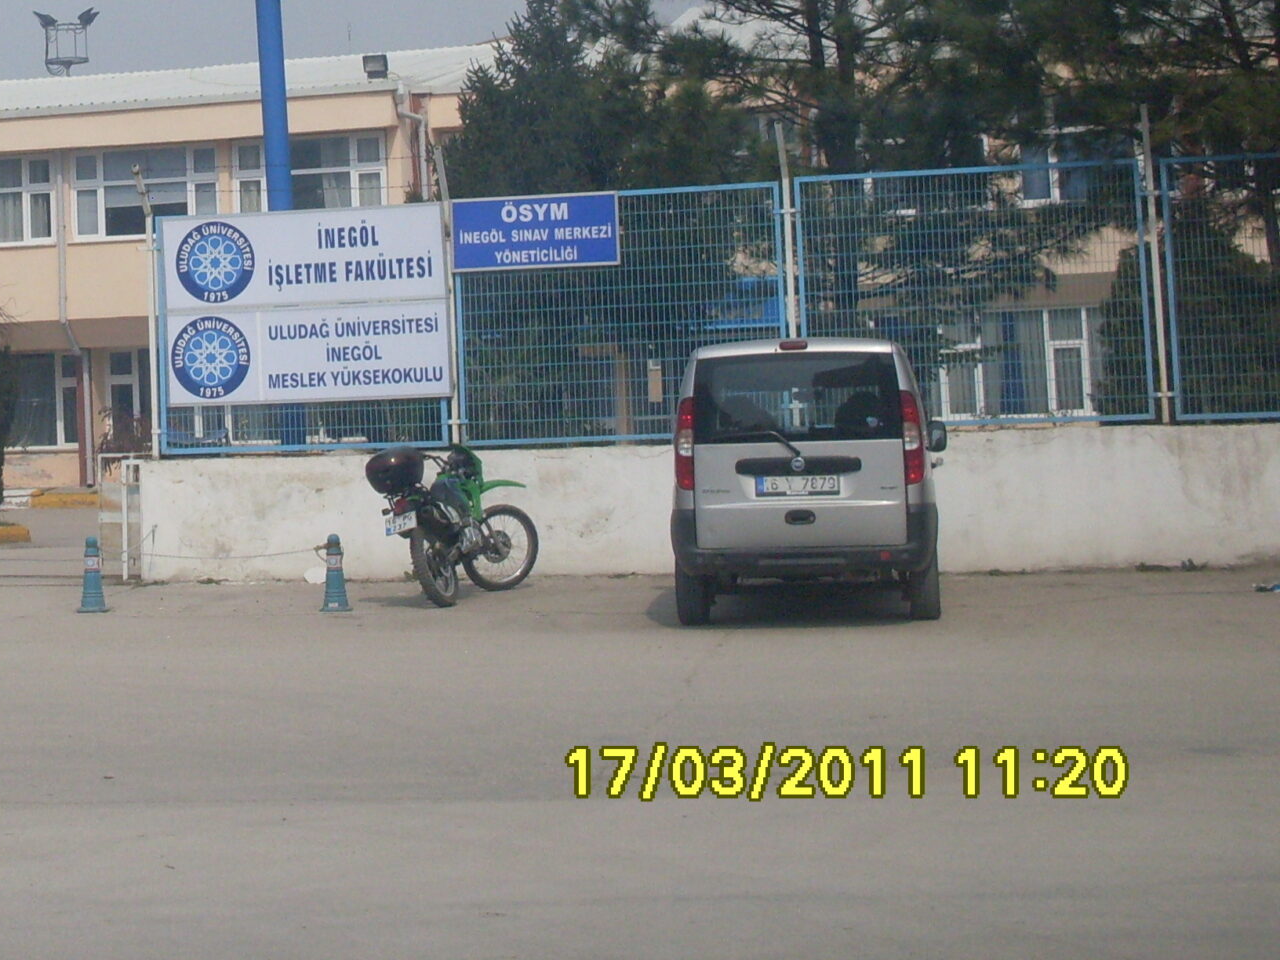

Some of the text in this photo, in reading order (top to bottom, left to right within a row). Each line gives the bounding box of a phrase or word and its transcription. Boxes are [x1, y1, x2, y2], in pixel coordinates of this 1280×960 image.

[500, 201, 568, 223] ÖSYM
[317, 219, 380, 250] İNEGÖL
[459, 222, 612, 245] İNEGÖL SINAV MERKEZİ
[494, 245, 578, 264] YÖNETİCİLİĞİ
[268, 249, 433, 292] İŞLETME FAKÜLTESİ
[203, 291, 229, 302] 1975
[268, 312, 439, 341] ULUDAĞ ÜNİVERSİTESİ
[326, 340, 383, 363] İNEGÖL
[268, 365, 443, 389] MESLEK YÜKSEKOKULU
[200, 386, 225, 397] 1975
